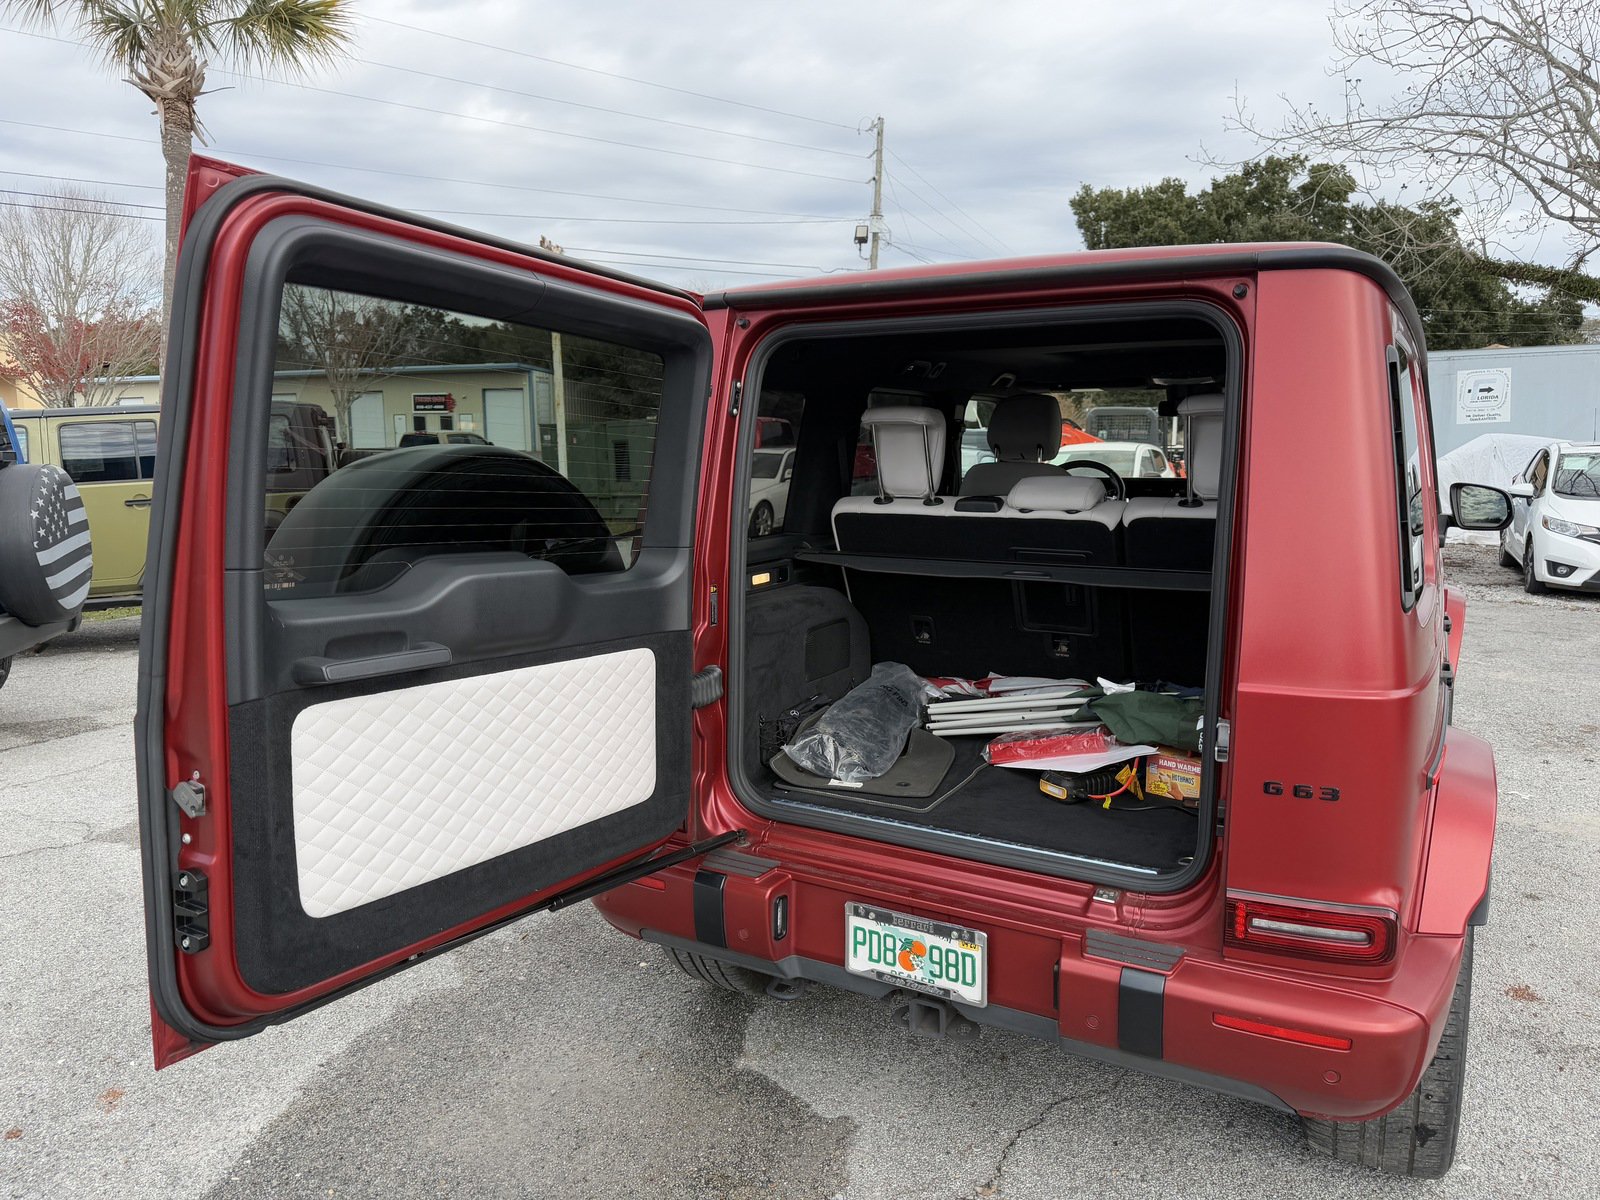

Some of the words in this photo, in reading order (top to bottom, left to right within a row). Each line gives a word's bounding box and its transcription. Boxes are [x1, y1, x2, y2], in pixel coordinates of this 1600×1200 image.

[1158, 759, 1176, 768] HAND
[892, 915, 935, 934] Ferrari
[853, 925, 897, 967] PD8
[928, 944, 977, 988] 98D
